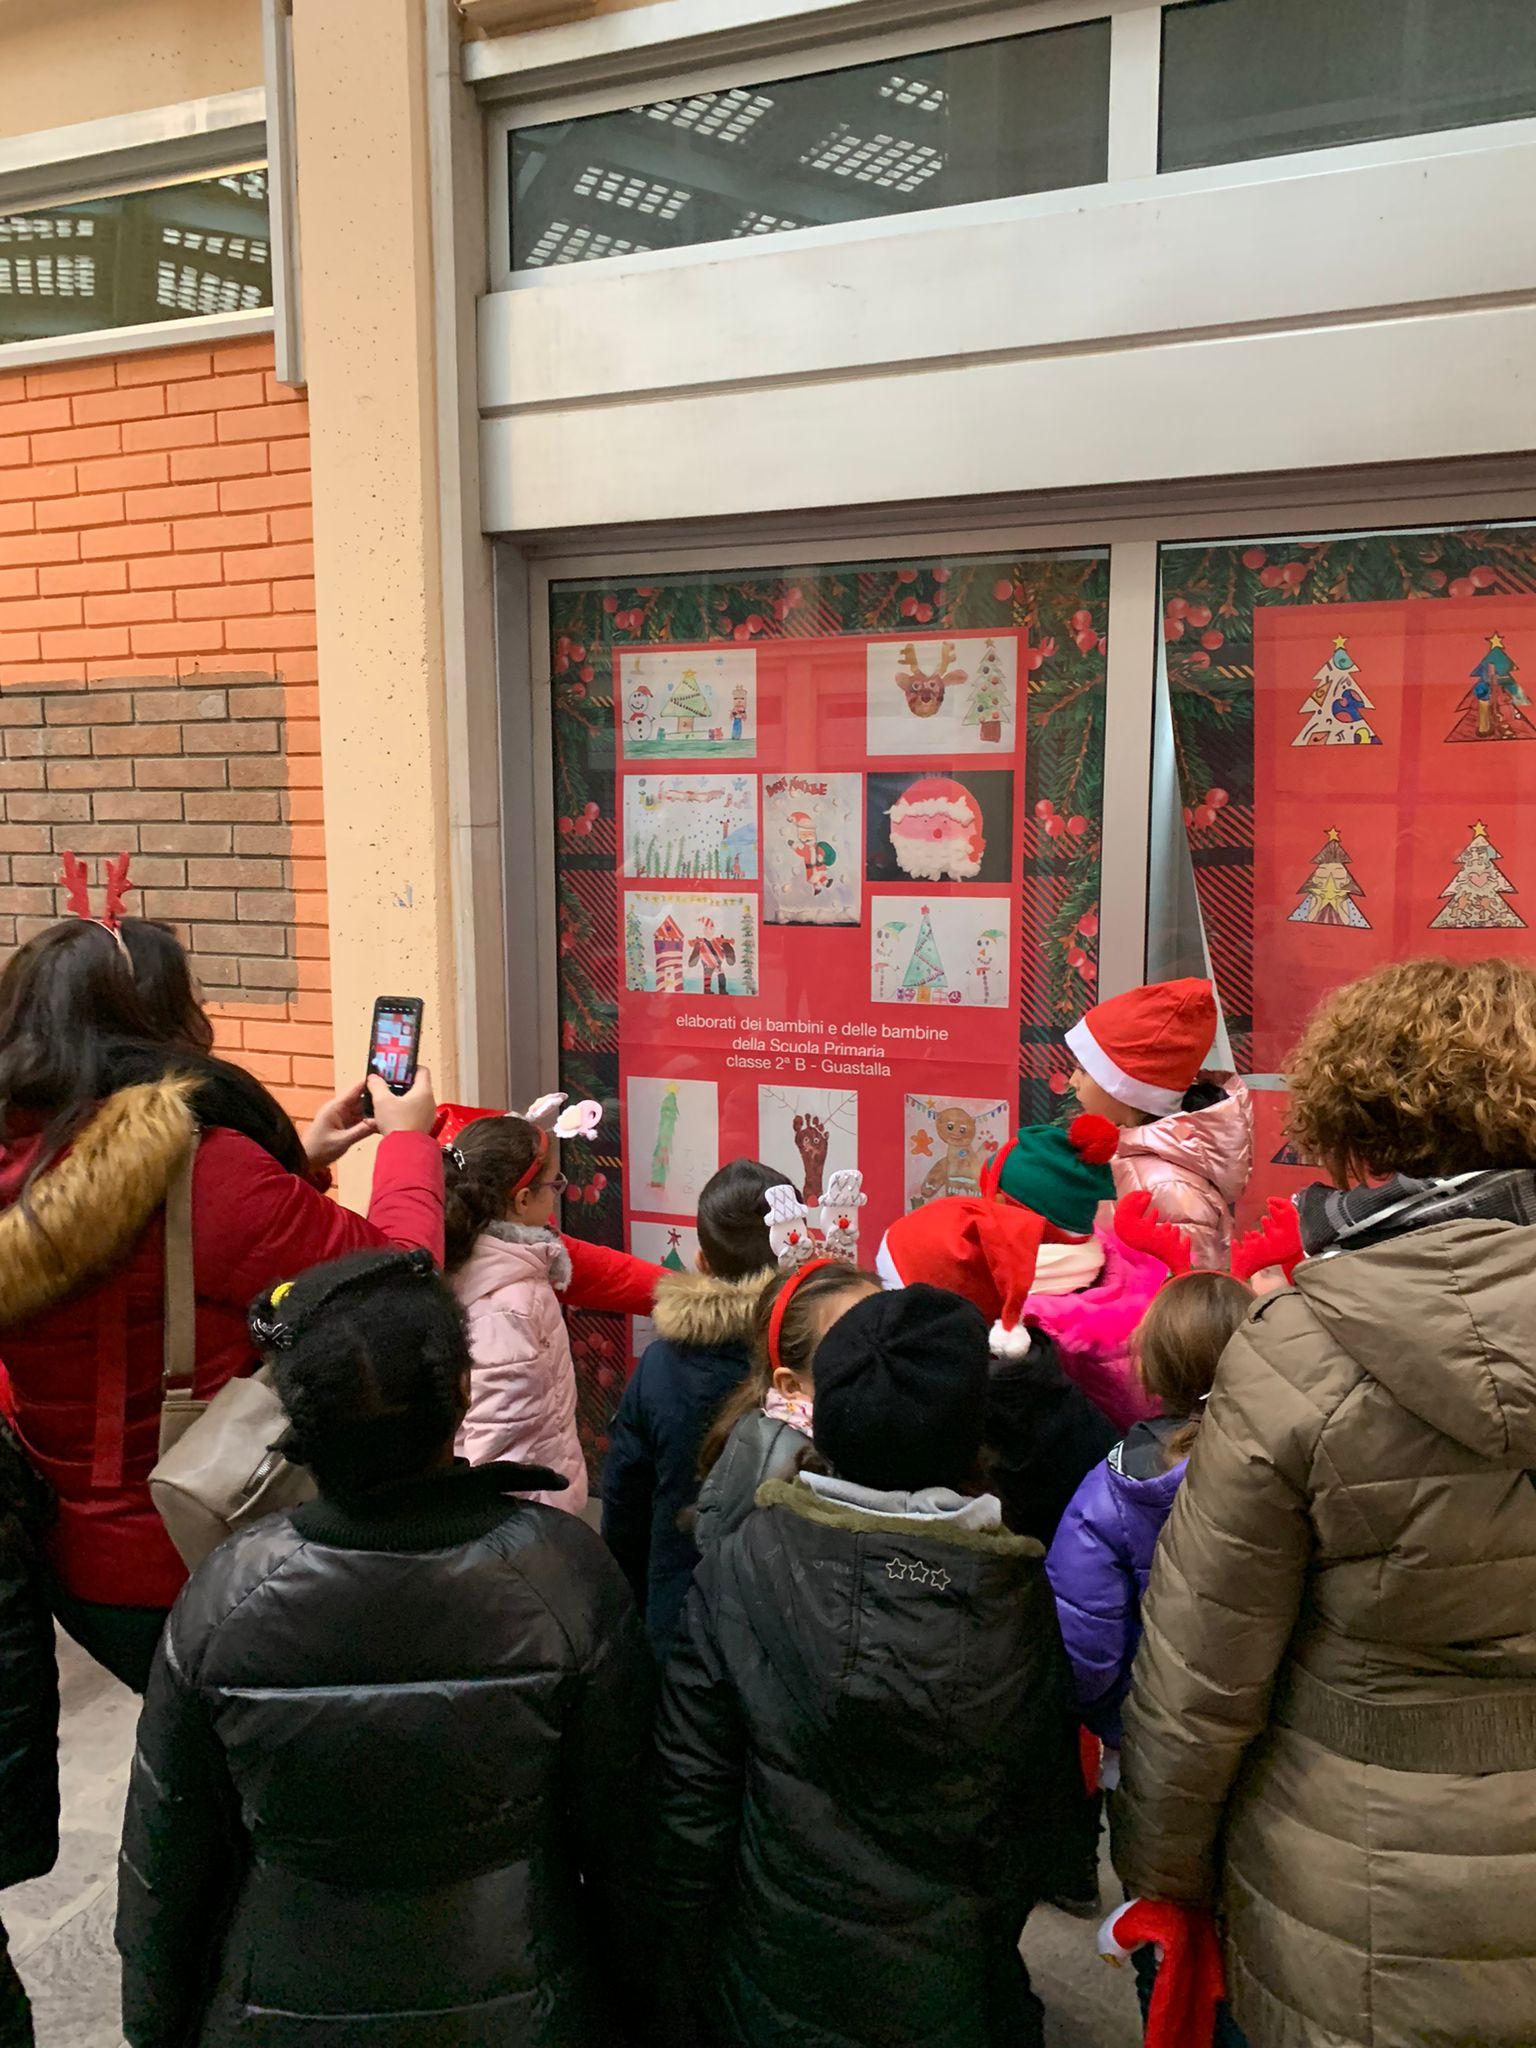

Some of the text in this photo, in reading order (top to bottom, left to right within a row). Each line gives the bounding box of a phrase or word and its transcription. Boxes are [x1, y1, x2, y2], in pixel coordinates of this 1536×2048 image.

[676, 1013, 949, 1041] elaborati dei bambini e delle bambine
[732, 1036, 885, 1058] della Scuola Primaria
[726, 1054, 772, 1069] classe
[795, 1057, 806, 1072] B
[821, 1058, 892, 1077] Guastalla
